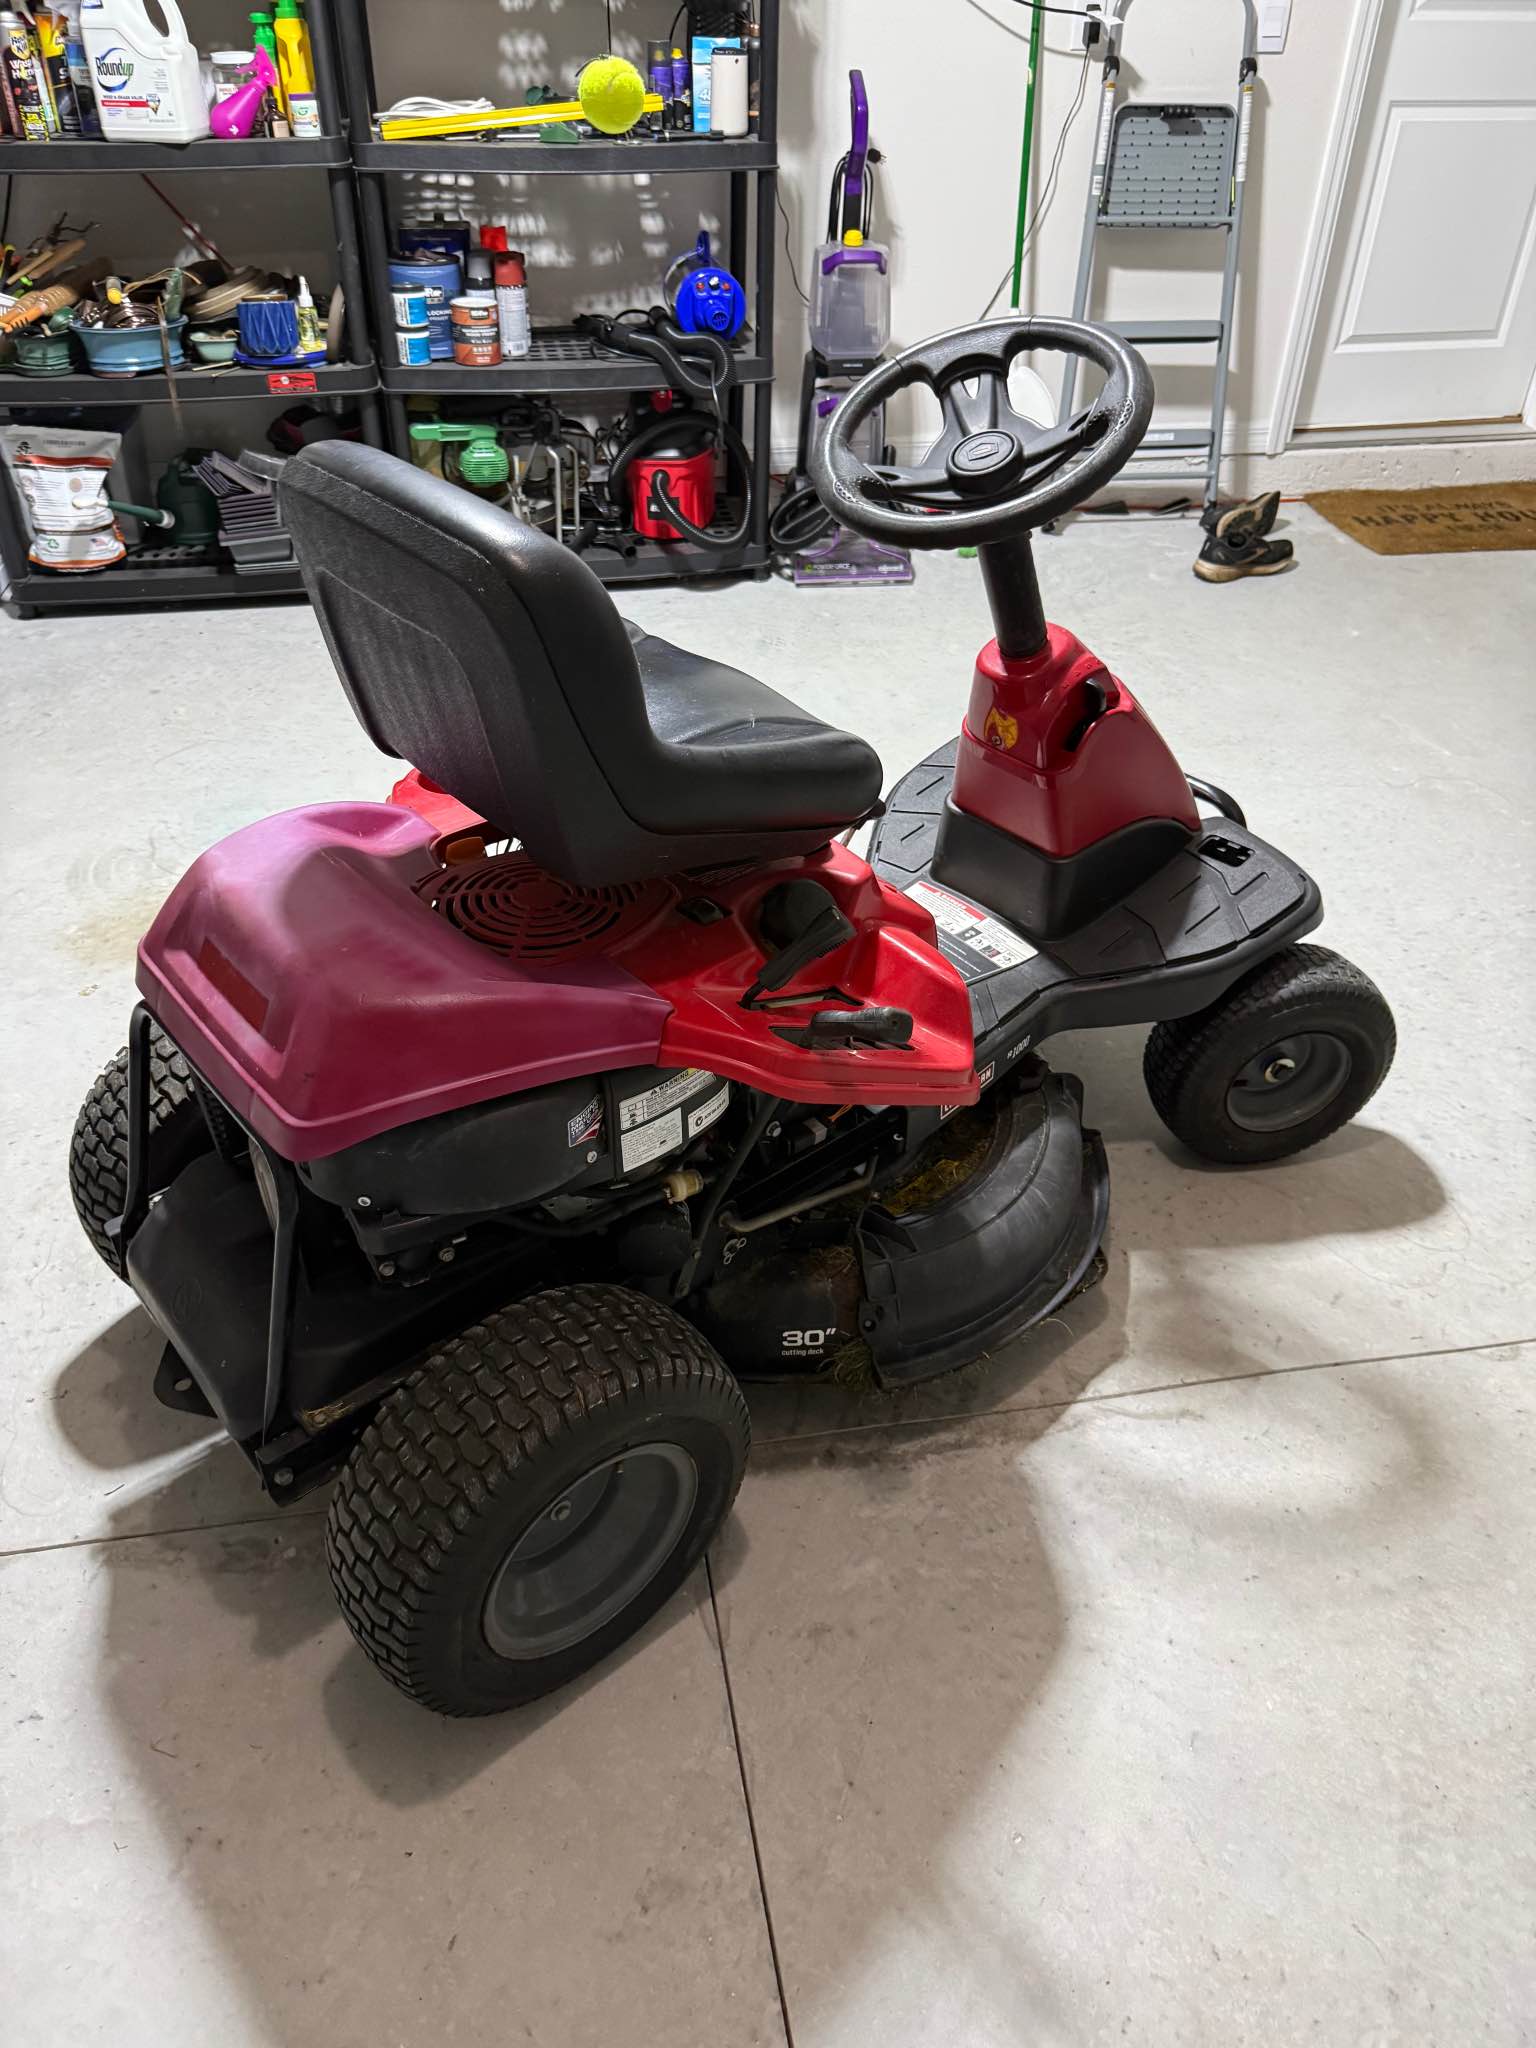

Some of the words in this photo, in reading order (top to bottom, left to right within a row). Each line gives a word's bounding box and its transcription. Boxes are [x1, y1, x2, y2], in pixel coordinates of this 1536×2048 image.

[95, 57, 134, 81] Roundup
[1352, 512, 1463, 526] HAPPY
[1473, 510, 1536, 522] HOU
[659, 1070, 689, 1091] WARNING
[782, 1327, 837, 1347] 30"
[781, 1348, 807, 1357] cutting
[808, 1347, 824, 1355] deck
